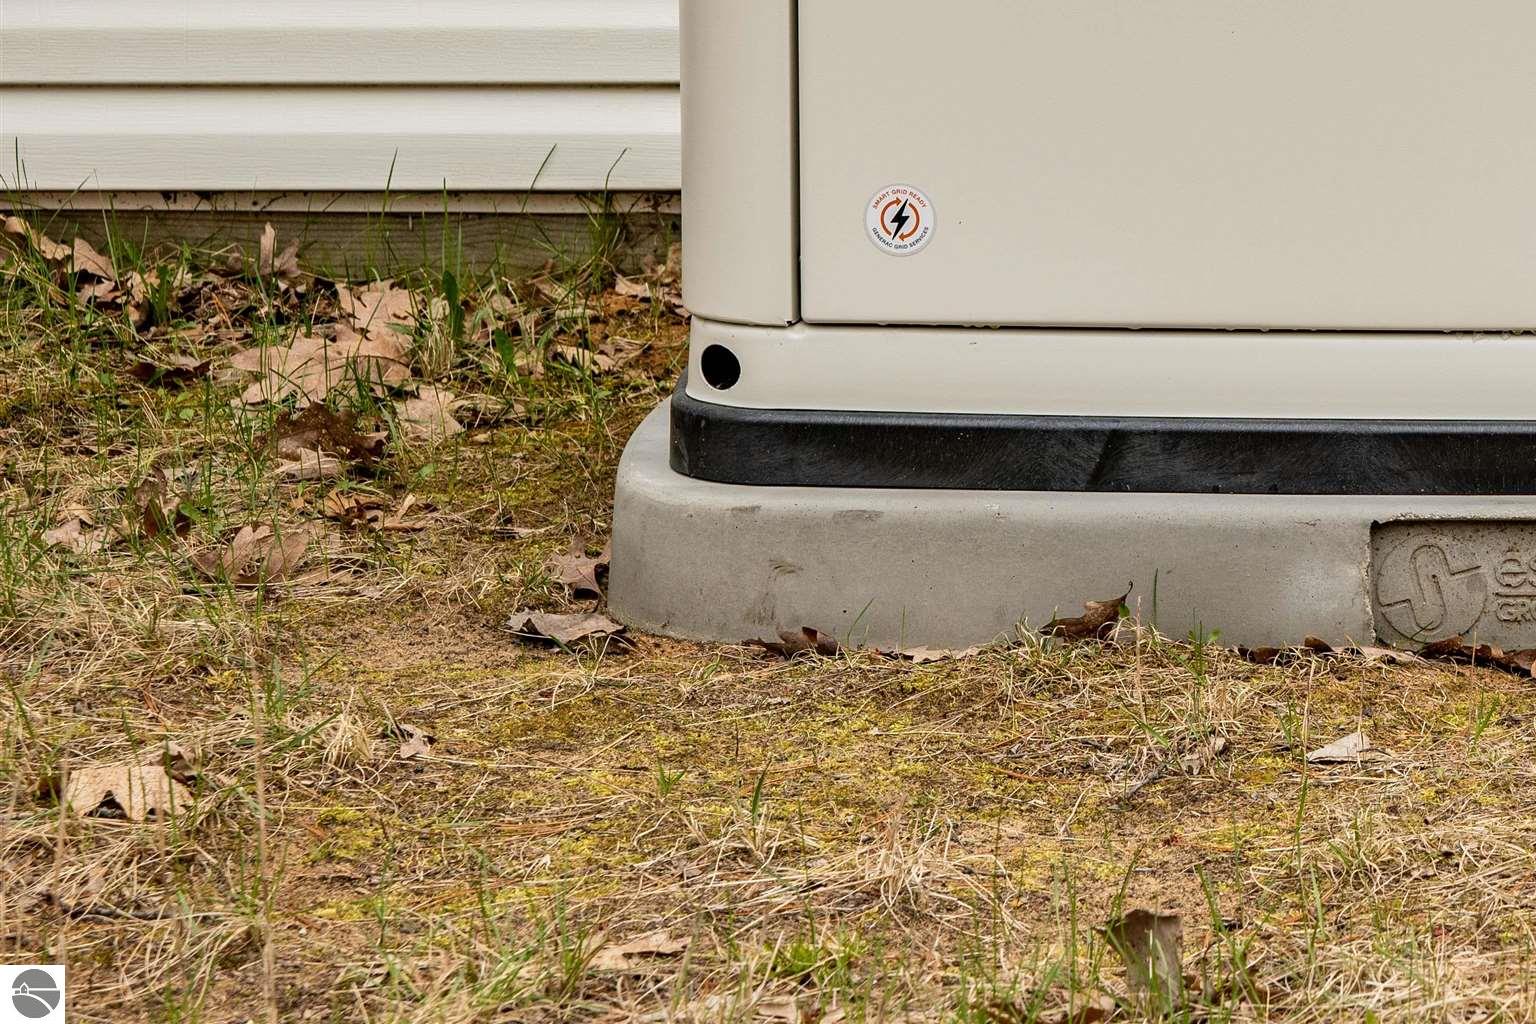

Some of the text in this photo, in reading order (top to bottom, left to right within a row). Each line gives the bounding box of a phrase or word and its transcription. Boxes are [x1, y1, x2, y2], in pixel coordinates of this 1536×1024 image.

[872, 191, 891, 209] SMART
[909, 191, 928, 208] READY
[872, 227, 893, 248] GENERAC
